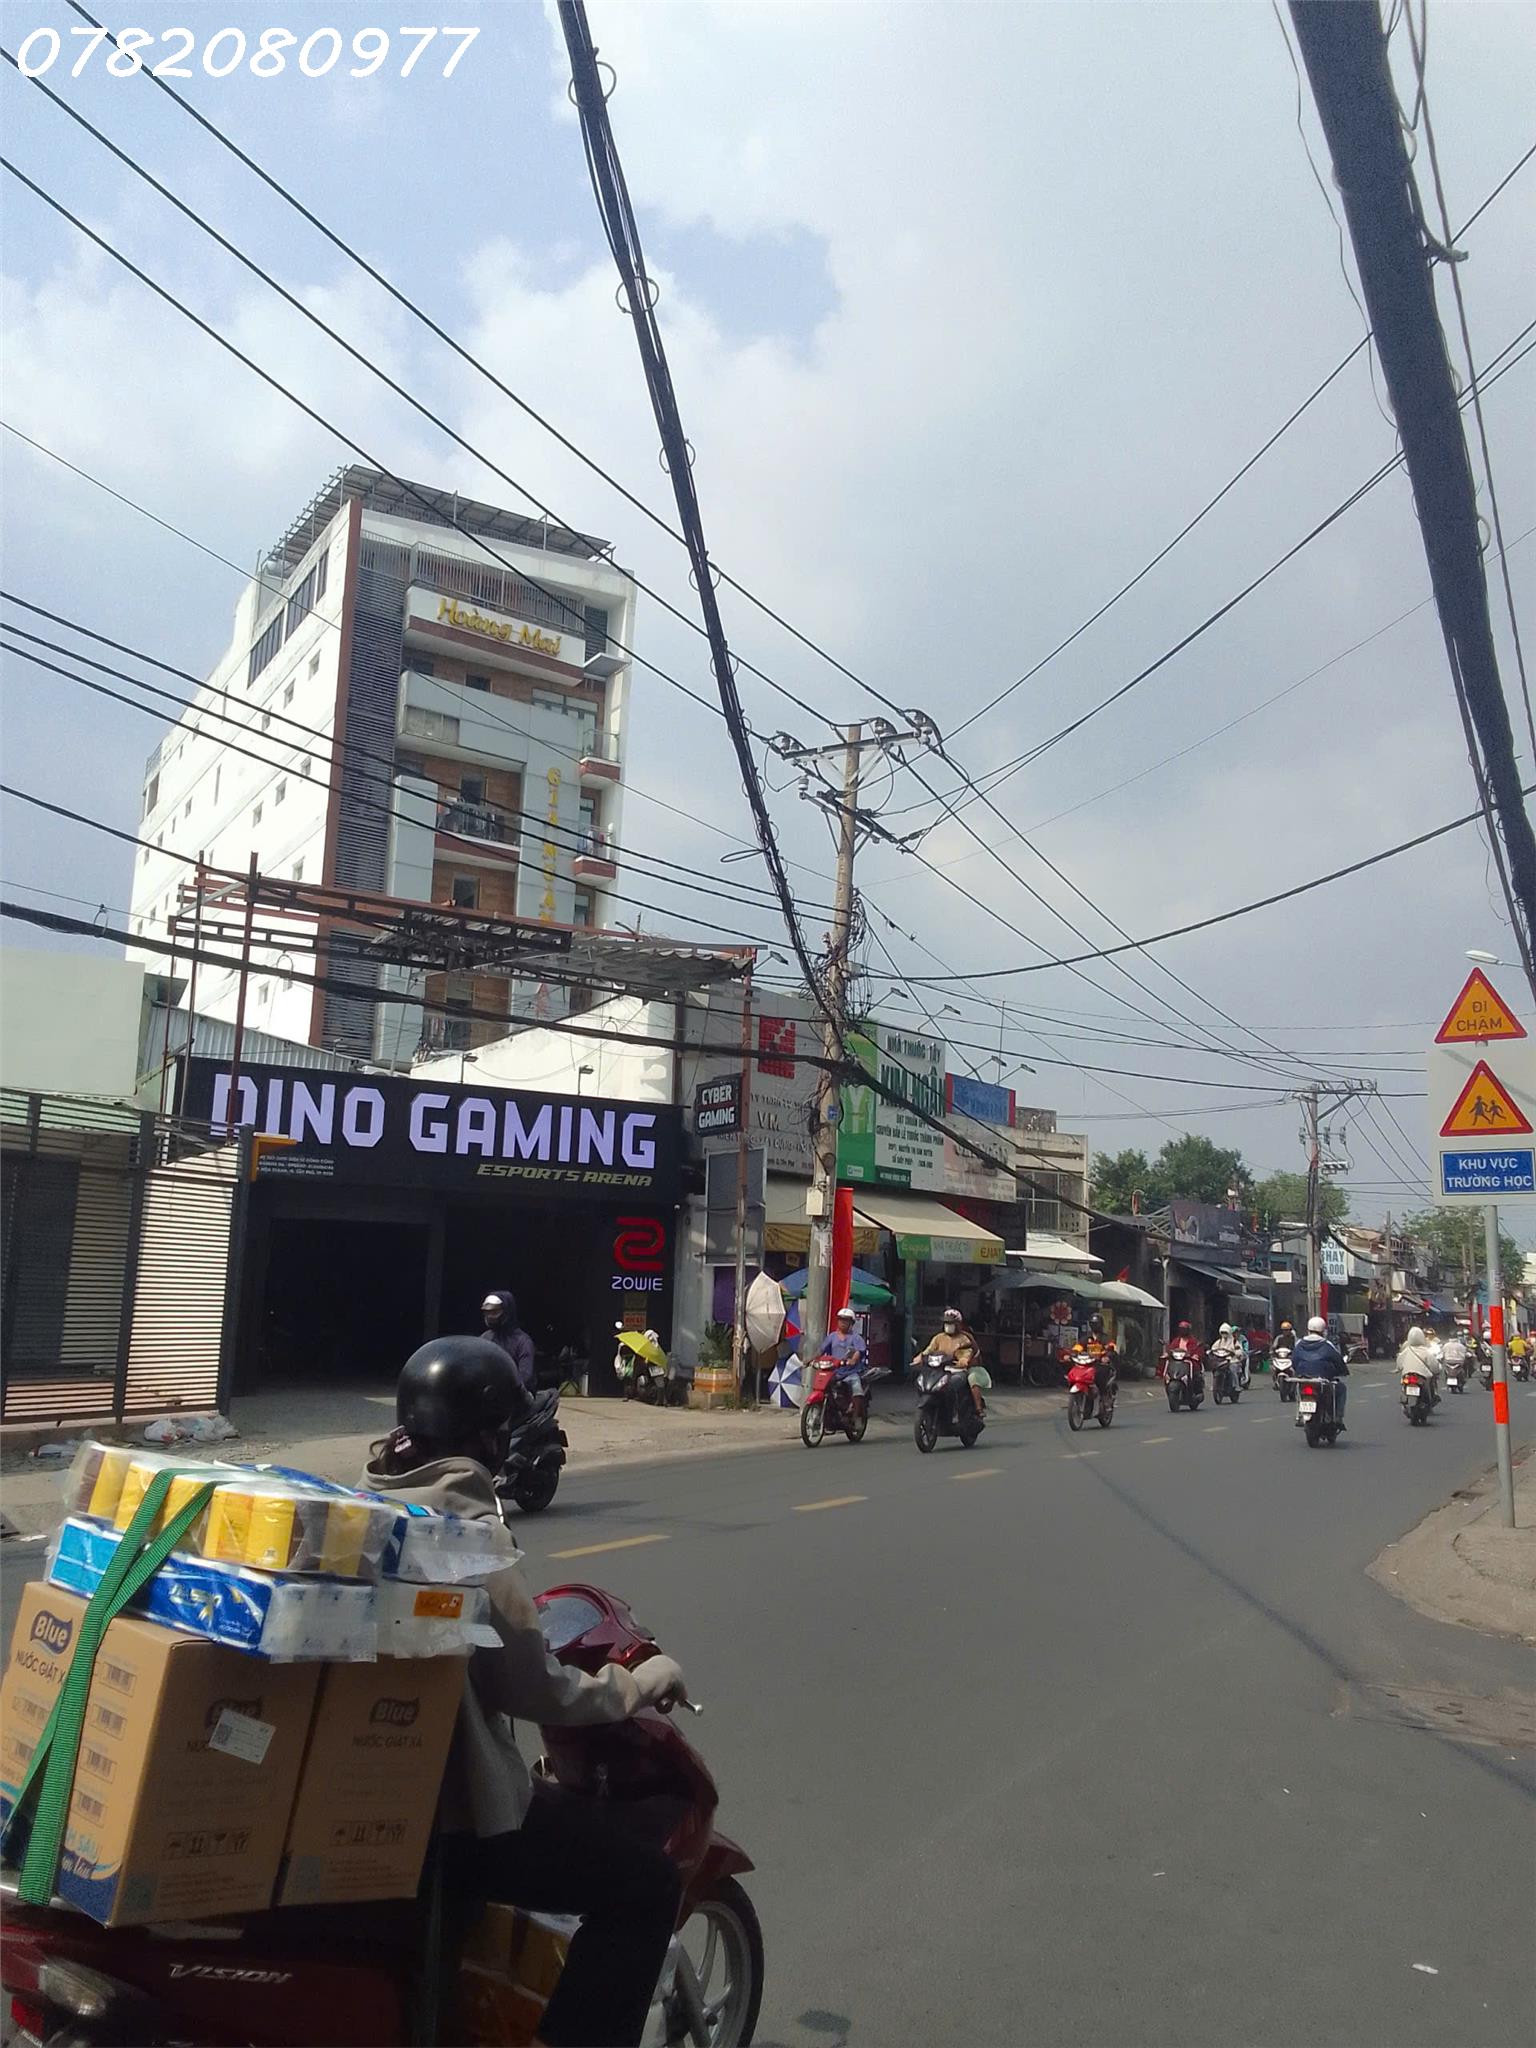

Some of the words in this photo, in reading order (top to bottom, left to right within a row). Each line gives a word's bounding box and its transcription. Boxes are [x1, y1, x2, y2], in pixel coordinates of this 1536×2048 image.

[437, 597, 512, 641] Hoàng
[1472, 1000, 1488, 1013] ĐI
[1456, 1015, 1503, 1034] CHẬM
[701, 1084, 732, 1106] CYBER
[209, 1073, 386, 1147] DINO
[408, 1092, 657, 1169] GAMING
[698, 1106, 735, 1128] GAMING
[1459, 1152, 1487, 1170] KHU
[1489, 1151, 1518, 1172] VỰC
[476, 1163, 580, 1182] ESPORTS
[582, 1171, 653, 1187] ARENA
[1446, 1170, 1501, 1189] TRƯỜNG
[1504, 1173, 1533, 1189] HỌC
[611, 1275, 663, 1292] ZOWIE
[34, 1615, 68, 1648] Blue
[15, 1649, 39, 1672] NƯỚC
[169, 1963, 293, 1984] VISION
